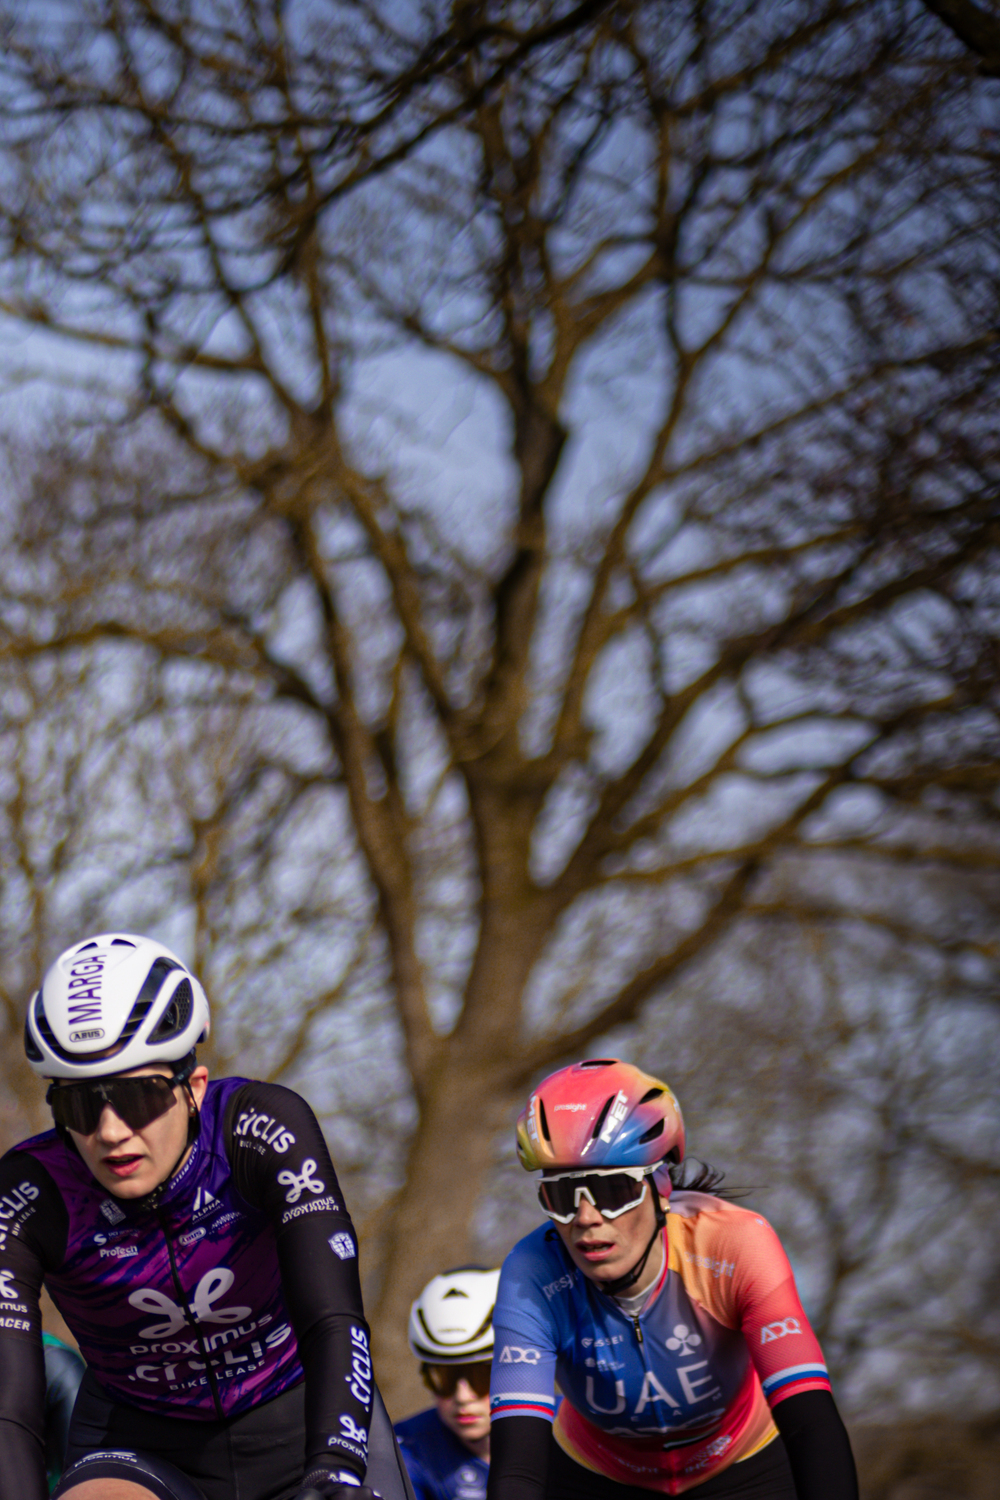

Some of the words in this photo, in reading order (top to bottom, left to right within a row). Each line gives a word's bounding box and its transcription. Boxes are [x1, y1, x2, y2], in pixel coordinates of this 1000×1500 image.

[67, 954, 108, 1026] MARGA
[73, 1030, 101, 1041] ABUS
[599, 1089, 629, 1144] MET
[191, 1199, 221, 1221] ALPHA
[129, 1313, 273, 1356] proximus
[169, 1376, 208, 1391] BIKE
[215, 1359, 266, 1380] LEASE
[585, 1360, 721, 1415] UAE
